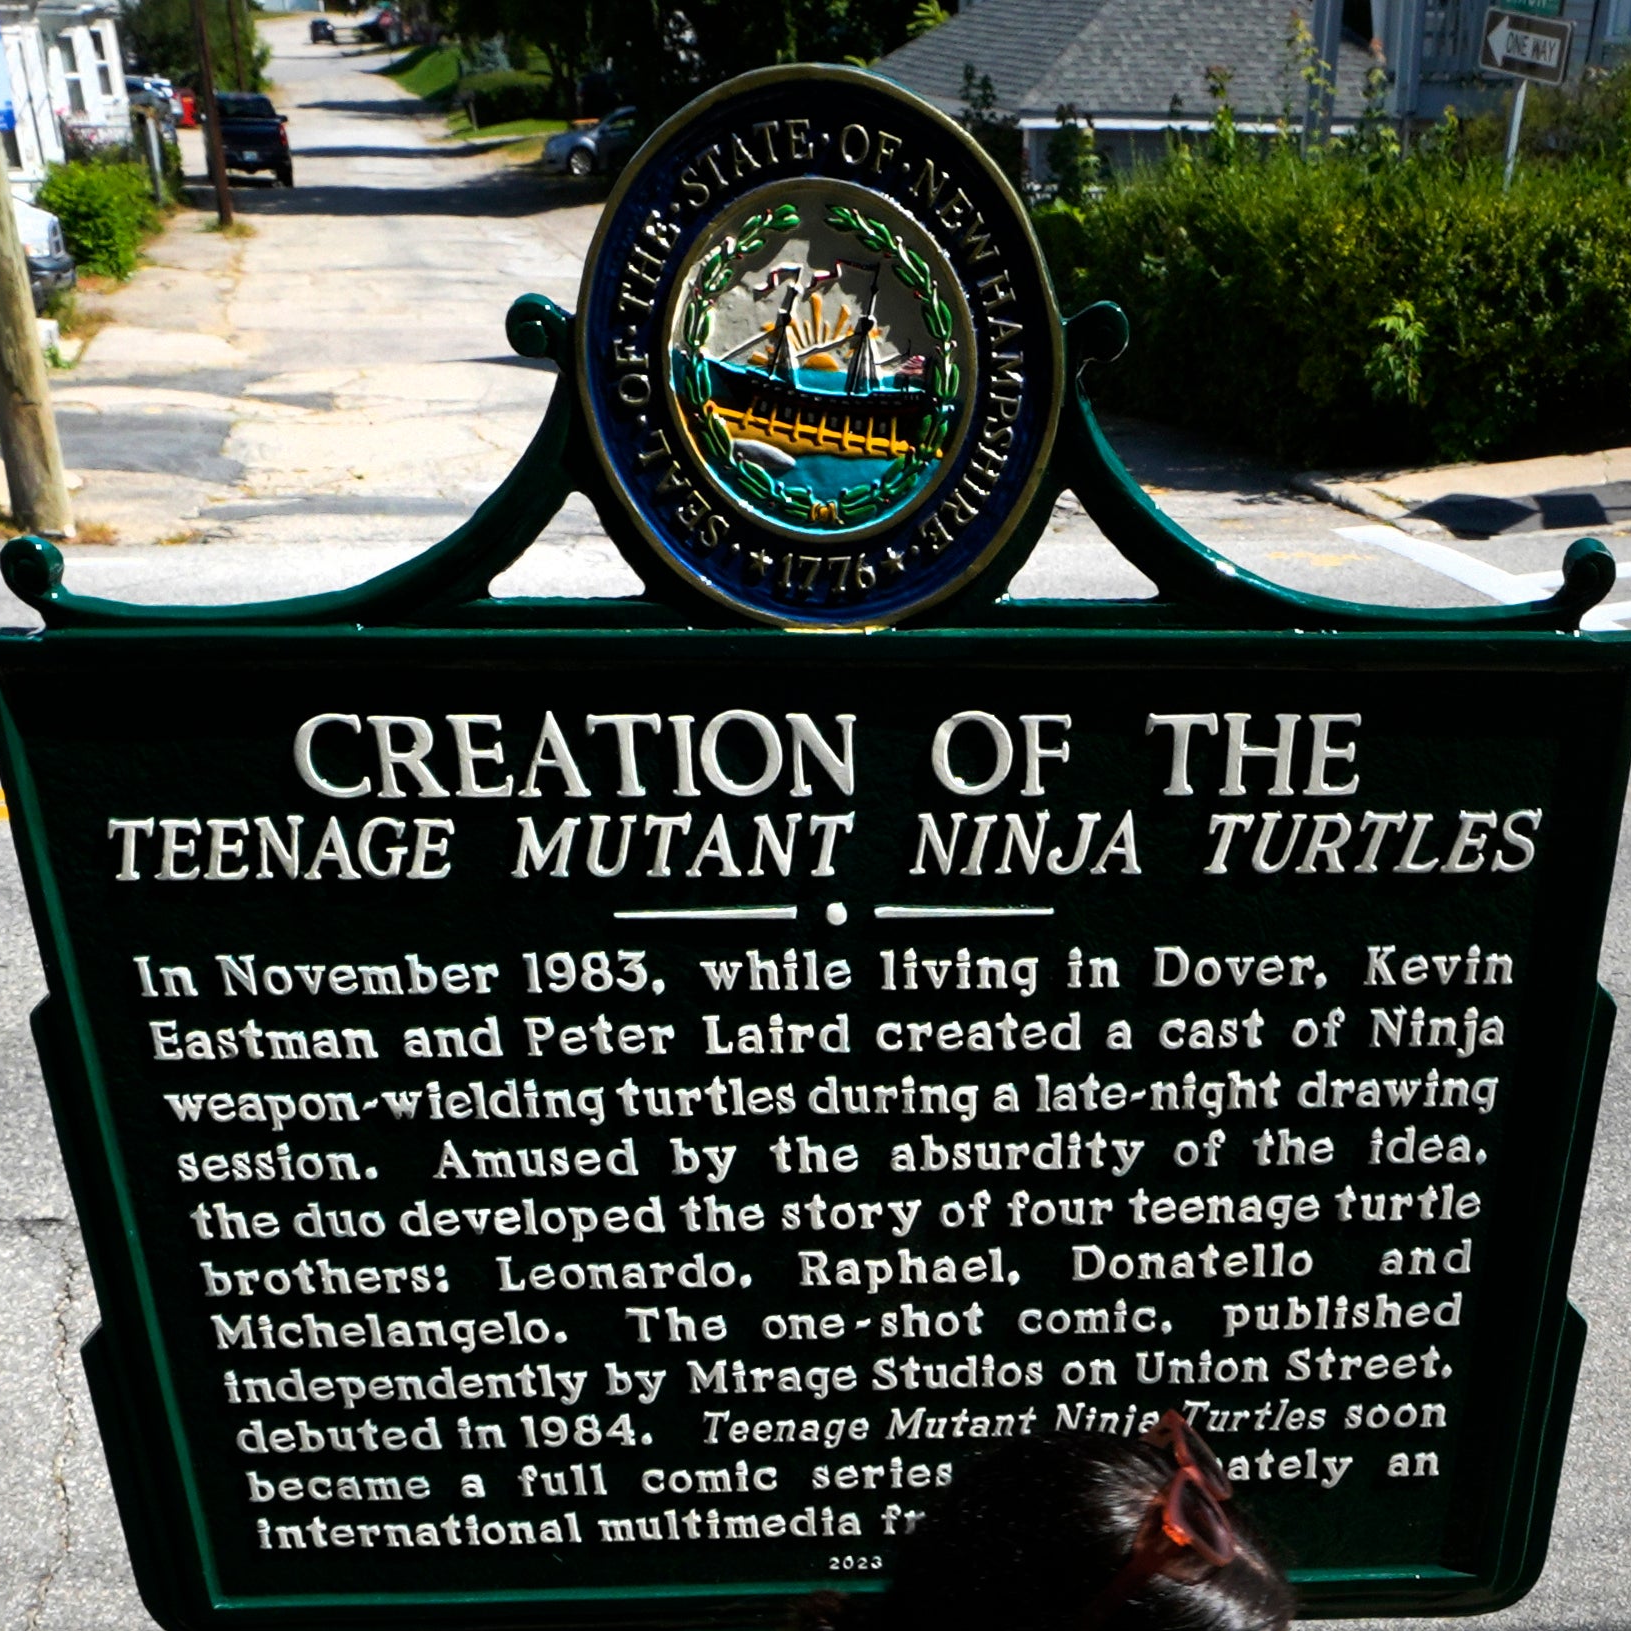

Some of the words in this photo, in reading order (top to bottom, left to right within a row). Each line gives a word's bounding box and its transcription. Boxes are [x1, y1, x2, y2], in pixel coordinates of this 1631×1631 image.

[1506, 30, 1528, 57] ONE
[1531, 37, 1557, 63] WAY
[680, 118, 814, 208] STATE
[840, 123, 903, 175] OF
[908, 157, 1001, 260] NEW
[619, 208, 682, 315] THE
[613, 338, 651, 404] OF
[919, 268, 1025, 551] HAMPSHIRE
[637, 428, 730, 548] SEAL
[777, 552, 877, 592] 1776
[294, 708, 857, 799] CREATION
[931, 709, 1073, 797] OF
[1147, 712, 1362, 797] THE
[107, 814, 456, 881] TEENAGE
[510, 810, 856, 879] MUTANT
[908, 808, 1143, 876] NINJA
[1203, 807, 1543, 875] TURTLES
[132, 955, 199, 998] In
[214, 953, 500, 997] November
[521, 948, 666, 996] 1983,
[699, 947, 852, 991] while
[879, 947, 1039, 998] living
[1066, 946, 1121, 989] in
[1153, 945, 1328, 990] Dover,
[1363, 943, 1514, 986] Kevin
[148, 1018, 380, 1061] Eastman
[403, 1015, 504, 1058] and
[522, 1013, 676, 1057] Peter
[701, 1012, 851, 1055] Laird
[875, 1010, 1082, 1052] created
[1106, 1019, 1133, 1050] a
[1159, 1007, 1265, 1050] cast
[1291, 1006, 1346, 1048] of
[1370, 1004, 1505, 1058] Ninja
[162, 1078, 606, 1132] weapon-wielding
[615, 1075, 797, 1117] turtles
[807, 1074, 980, 1123] during
[993, 1082, 1020, 1113] a
[1034, 1069, 1282, 1119] late-night
[1297, 1067, 1500, 1114] drawing
[177, 1142, 379, 1182] session.
[432, 1136, 640, 1180] Amused
[669, 1137, 737, 1184] by
[768, 1134, 859, 1174] the
[891, 1130, 1146, 1177] absurdity
[1173, 1128, 1227, 1167] of
[1252, 1127, 1335, 1166] the
[1369, 1124, 1488, 1165] idea,
[189, 1201, 281, 1240] the
[293, 1201, 386, 1238] duo
[399, 1194, 666, 1243] developed
[678, 1193, 765, 1233] the
[781, 1193, 923, 1238] story
[939, 1188, 992, 1228] of
[1006, 1189, 1114, 1227] four
[1127, 1187, 1321, 1230] teenage
[1334, 1182, 1482, 1222] turtle
[199, 1258, 450, 1297] brothers:
[495, 1252, 753, 1292] Leonardo,
[797, 1246, 1021, 1295] Raphael,
[1071, 1241, 1314, 1281] Donatello
[1379, 1237, 1473, 1276] and
[209, 1310, 568, 1354] Michelangelo.
[625, 1306, 728, 1343] The
[762, 1301, 985, 1340] one-shot
[1018, 1297, 1173, 1335] comic,
[1222, 1291, 1463, 1338] published
[223, 1363, 588, 1410] independently
[604, 1361, 667, 1405] by
[686, 1358, 858, 1400] Mirage
[871, 1353, 1044, 1391] Studios
[1061, 1358, 1118, 1386] on
[1135, 1348, 1270, 1384] Union
[1285, 1344, 1453, 1382] Street,
[236, 1416, 443, 1454] debuted
[457, 1415, 507, 1450] in
[519, 1412, 653, 1449] 1984.
[703, 1409, 870, 1449] Teenage
[885, 1406, 1037, 1440] Mutant
[1055, 1401, 1160, 1438] Ninja
[1182, 1397, 1327, 1433] Turtles
[1344, 1402, 1447, 1429] soon
[245, 1470, 431, 1503] became
[460, 1473, 486, 1499] a
[517, 1462, 608, 1497] full
[641, 1459, 778, 1494] comic
[811, 1455, 953, 1490] series
[1387, 1451, 1440, 1478] an
[256, 1511, 583, 1550] international
[597, 1505, 862, 1543] multimedia
[829, 1555, 883, 1570] 2023
